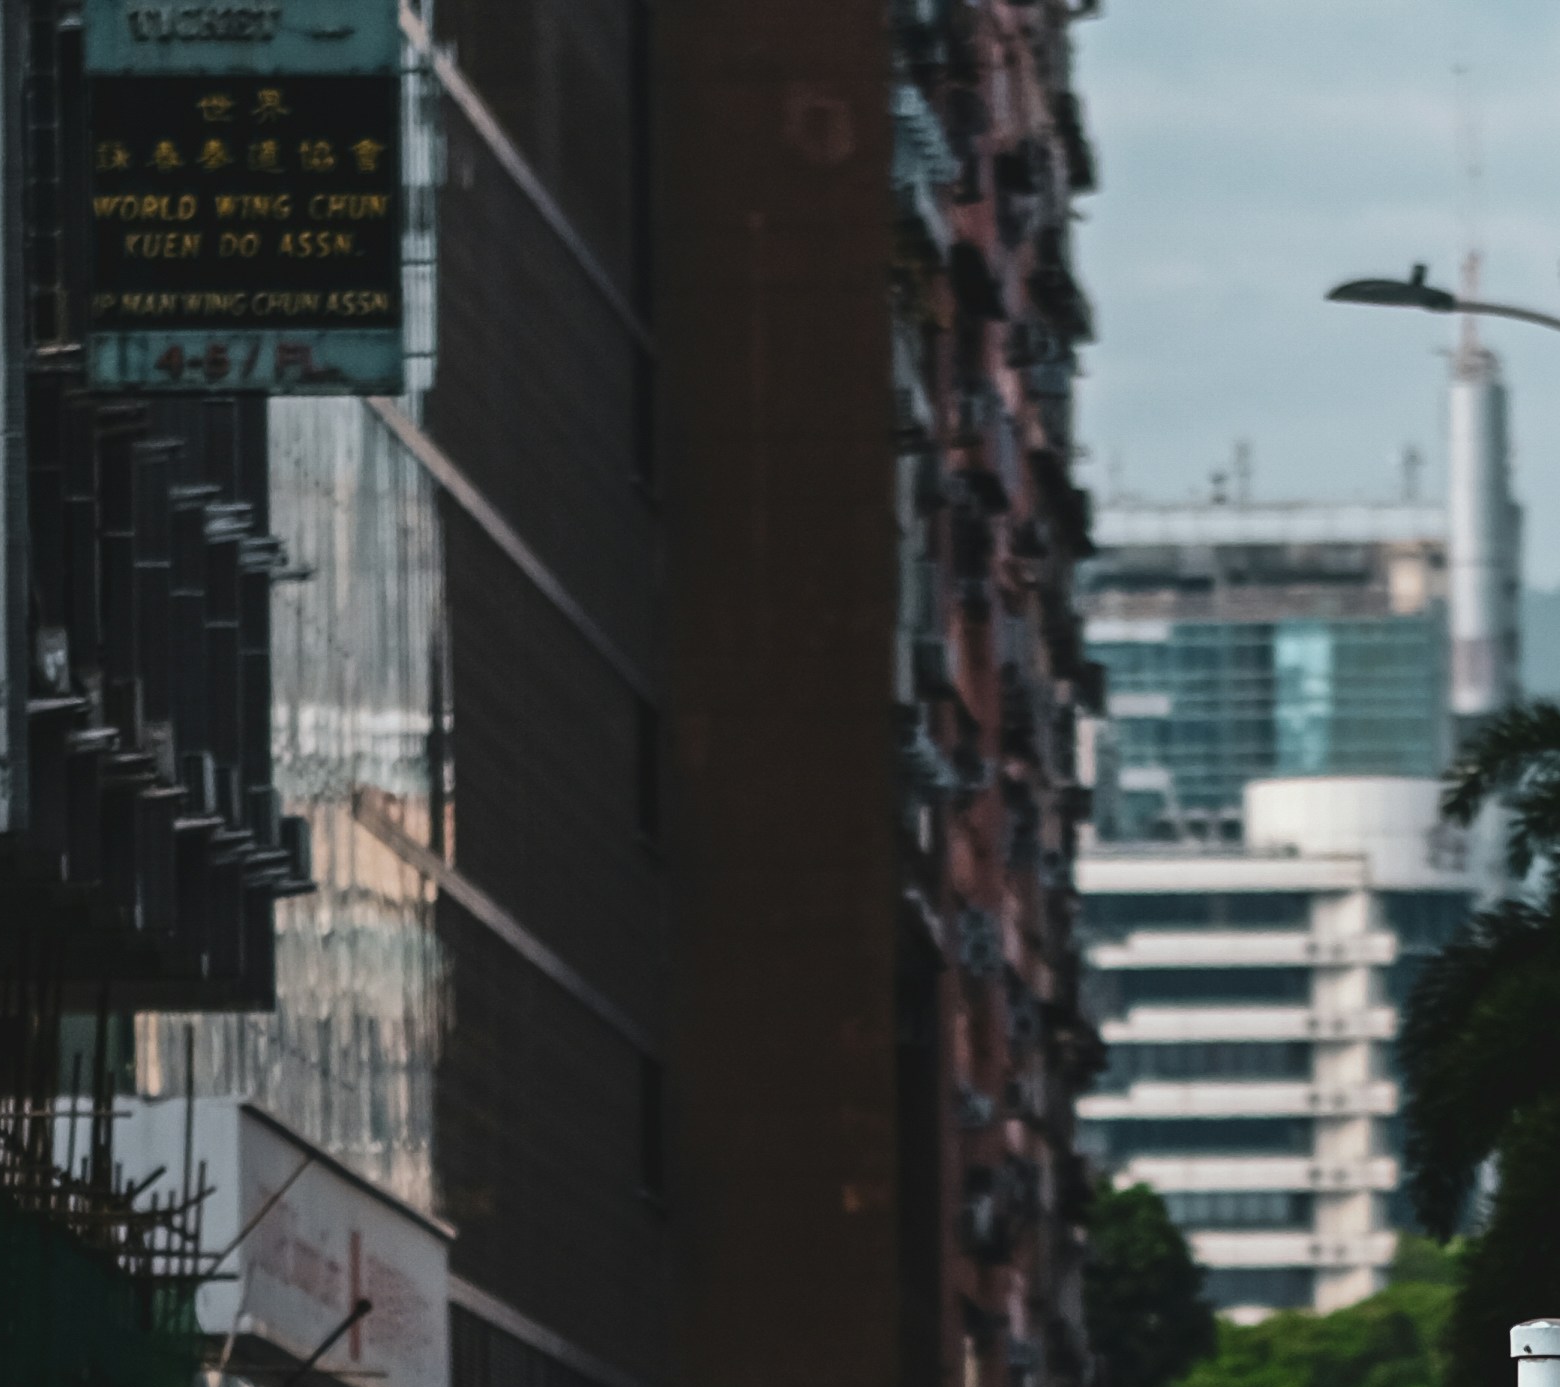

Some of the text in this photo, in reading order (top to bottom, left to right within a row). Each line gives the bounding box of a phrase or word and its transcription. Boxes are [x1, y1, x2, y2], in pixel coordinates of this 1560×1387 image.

[194, 86, 291, 124] 世界
[92, 193, 388, 221] WORLD WING CHUN
[125, 231, 201, 258] KUEN
[218, 231, 261, 258] DO
[120, 290, 177, 316] MAN
[250, 290, 320, 317] CHUN
